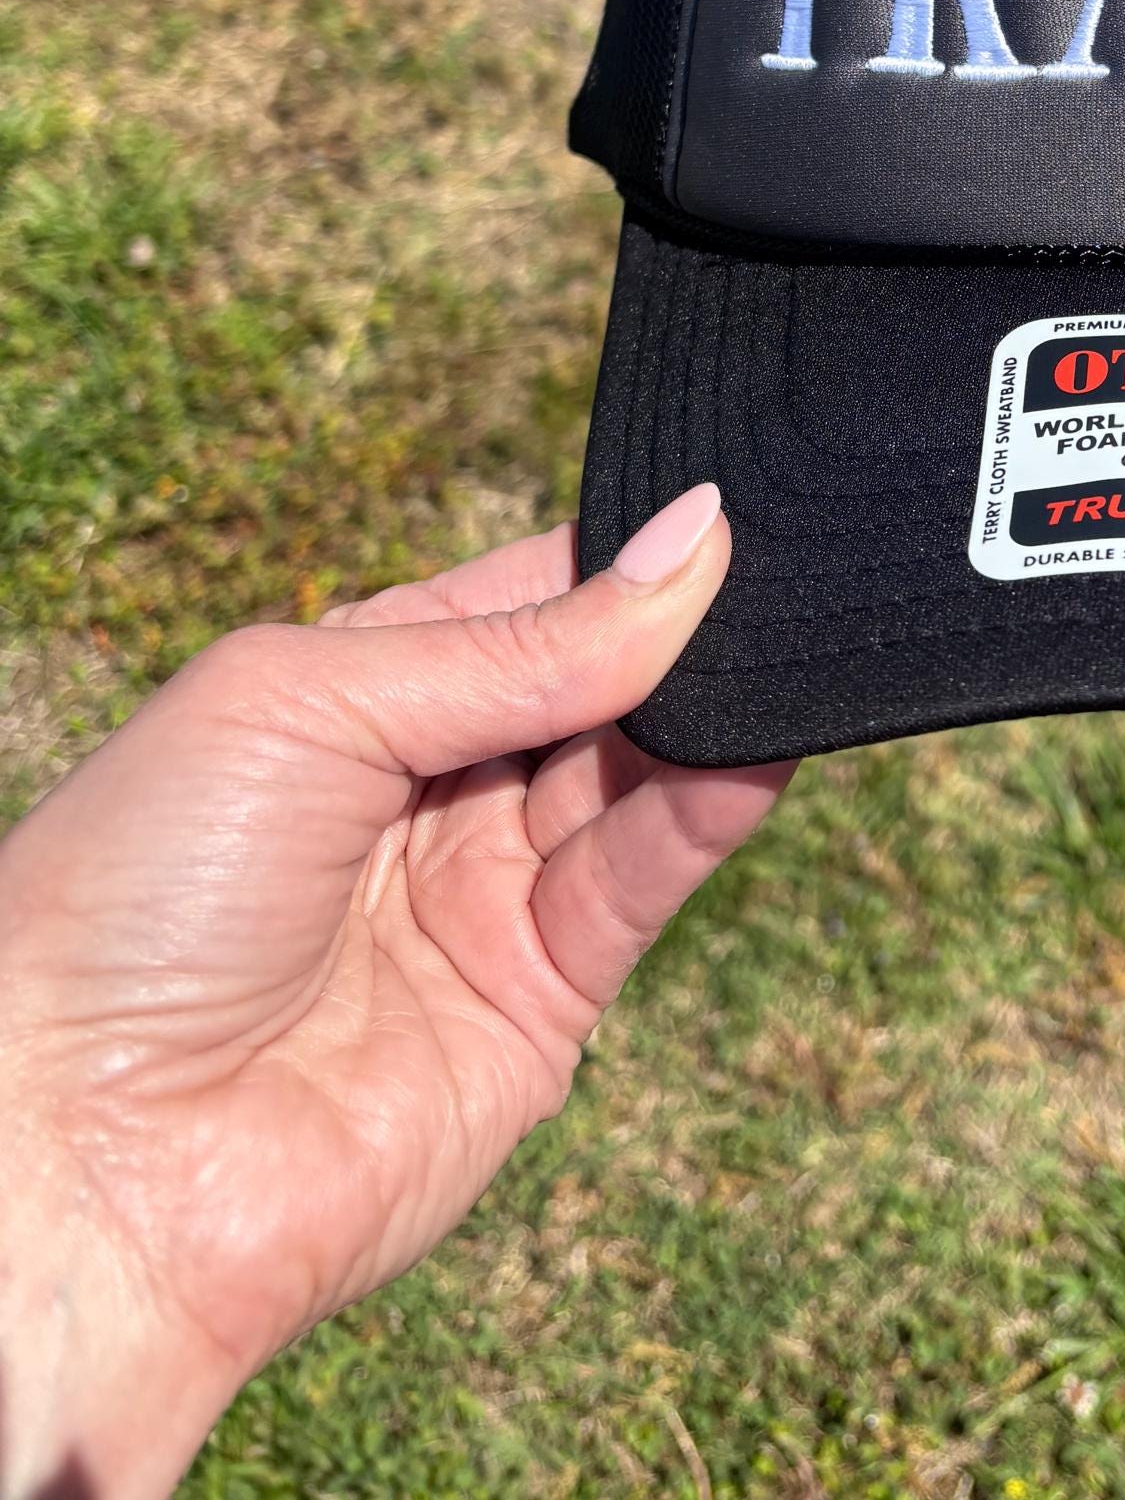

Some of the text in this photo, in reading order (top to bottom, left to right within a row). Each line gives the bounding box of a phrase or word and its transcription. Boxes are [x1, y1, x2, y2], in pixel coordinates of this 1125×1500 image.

[983, 357, 1018, 544] TERRY CLOTH SWEATBAND
[1024, 549, 1114, 568] DURABLE
